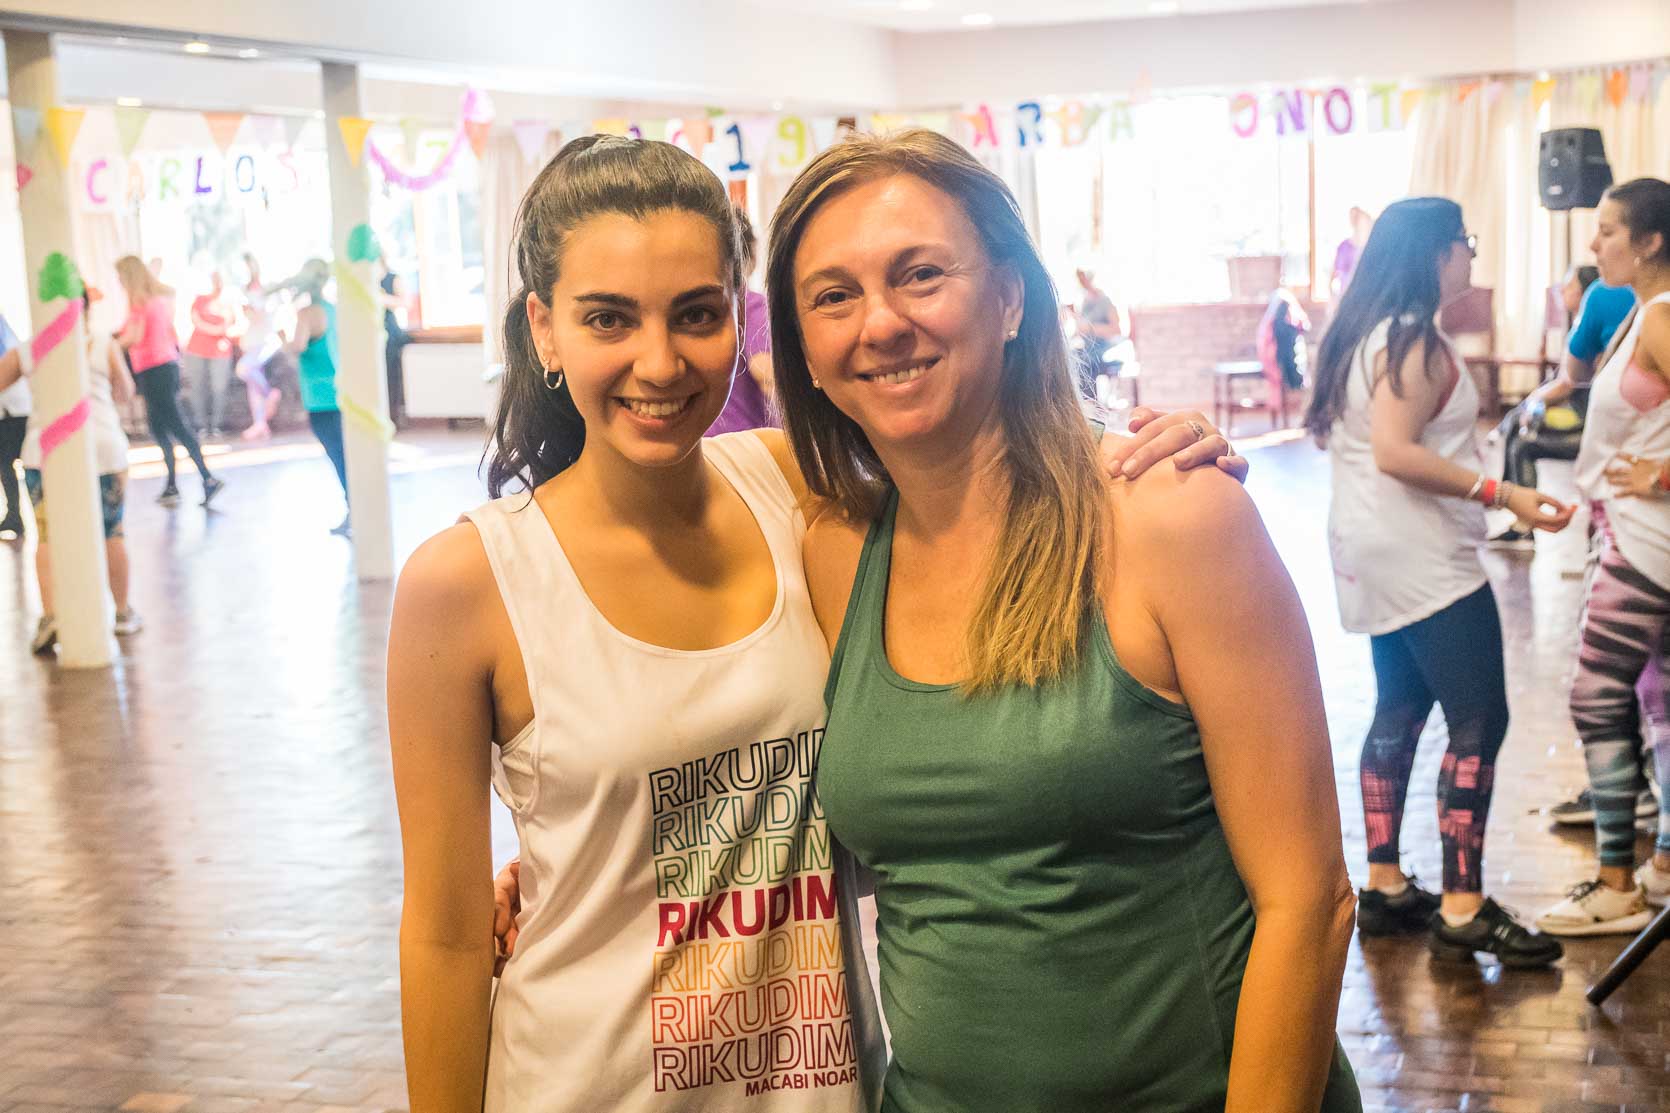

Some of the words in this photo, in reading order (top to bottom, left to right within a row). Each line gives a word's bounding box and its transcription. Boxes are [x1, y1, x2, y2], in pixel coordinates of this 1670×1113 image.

[656, 874, 839, 947] RIKUDIM
[652, 924, 845, 993] RIKUDIM
[651, 971, 852, 1044] RIKUDIM
[653, 1019, 858, 1093] RIKUDIM
[745, 1072, 809, 1097] MACABI
[813, 1066, 858, 1089] NOAR
